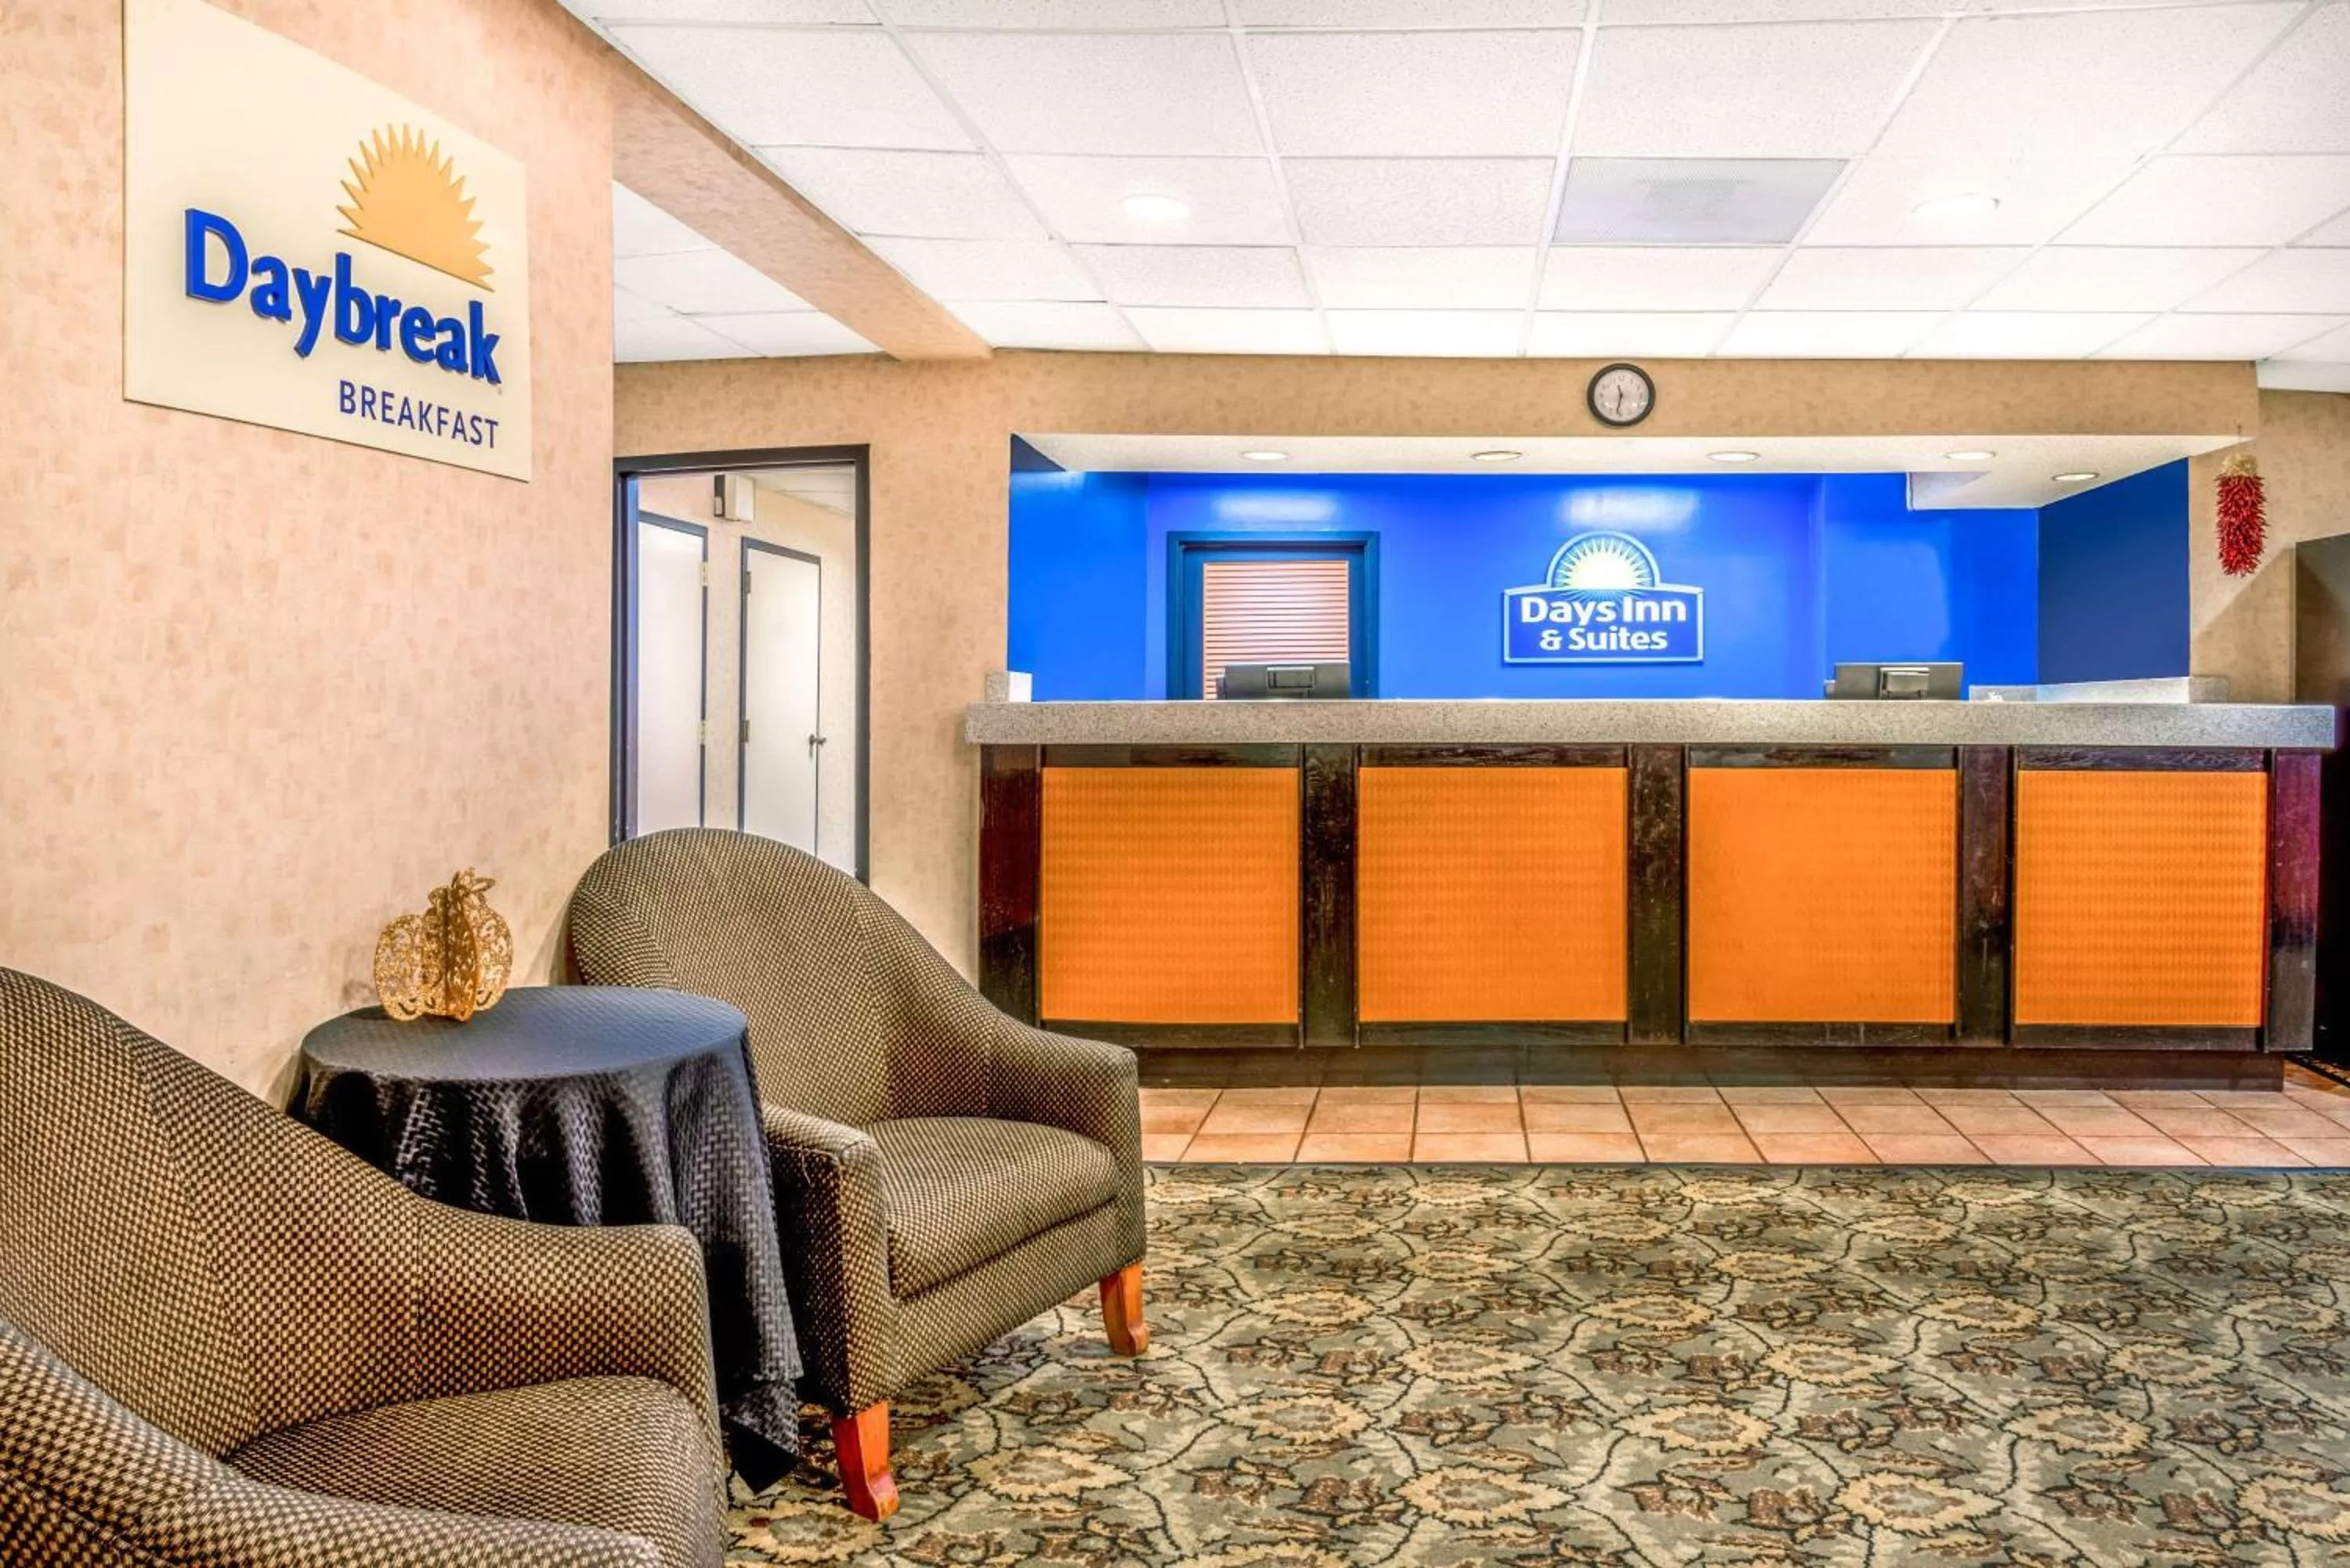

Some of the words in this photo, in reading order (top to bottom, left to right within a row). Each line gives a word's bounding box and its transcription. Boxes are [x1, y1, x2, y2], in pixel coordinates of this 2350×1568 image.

[184, 208, 502, 385] Daybreak
[339, 379, 499, 449] BREAKFAST
[1520, 596, 1617, 627] Days
[1622, 596, 1687, 623] Inn
[1538, 628, 1564, 651] &
[1568, 626, 1668, 651] Suites
